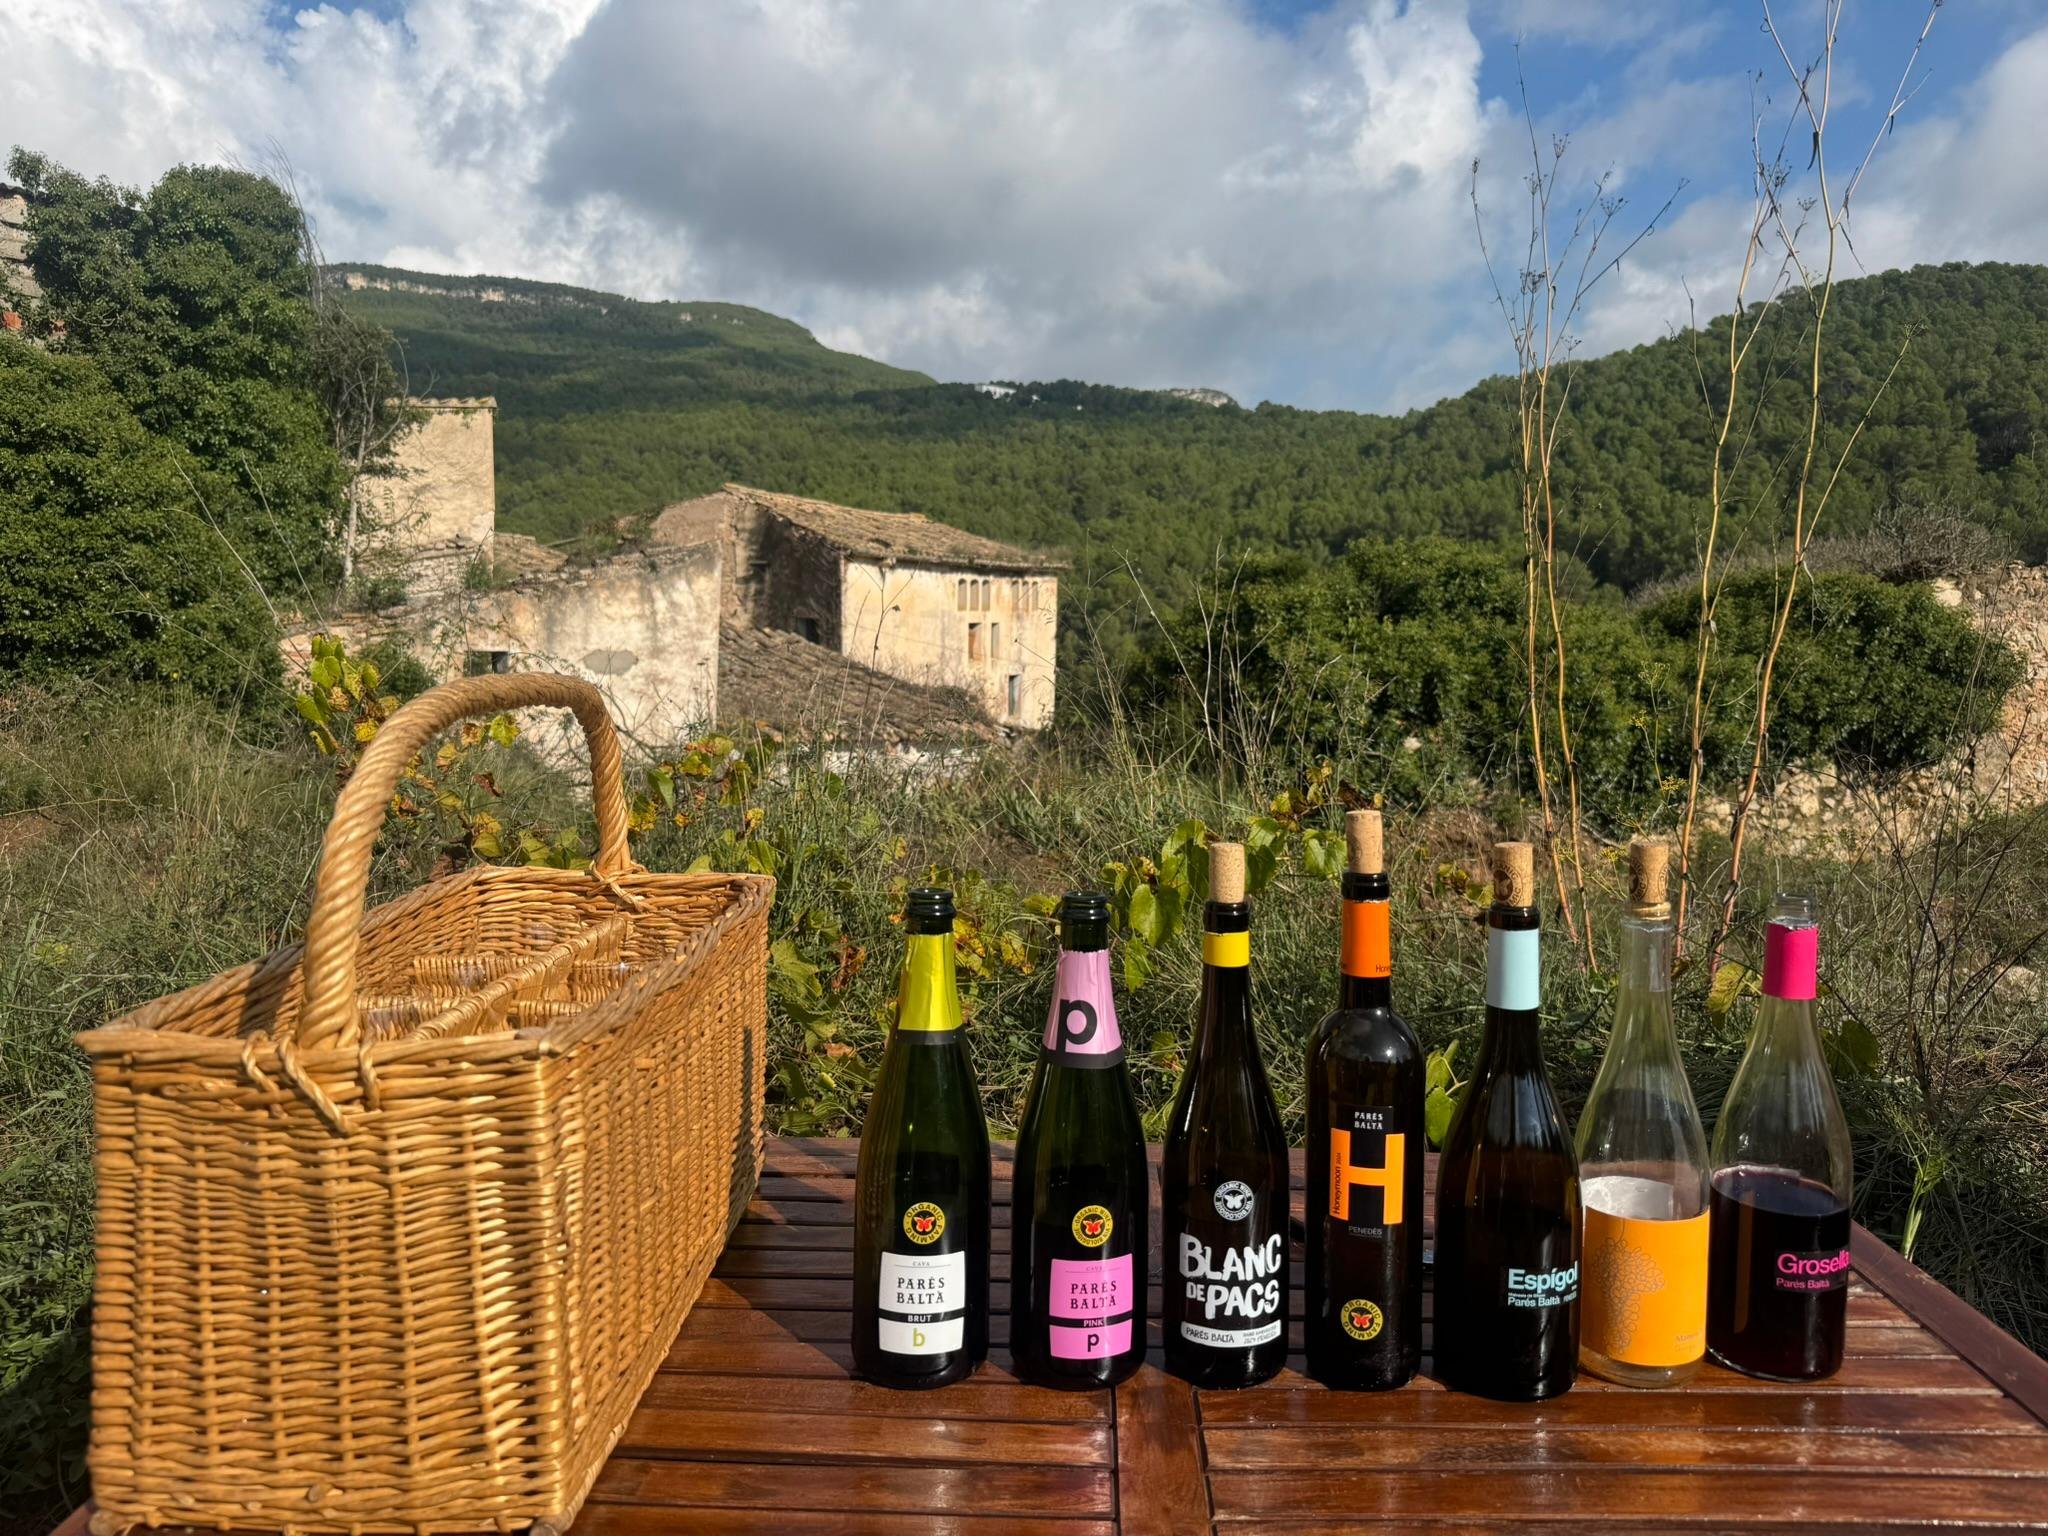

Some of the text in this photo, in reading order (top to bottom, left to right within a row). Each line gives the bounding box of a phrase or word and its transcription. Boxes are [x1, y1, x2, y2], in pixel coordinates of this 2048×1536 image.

[905, 1203, 943, 1243] ORGANIC FARMING
[1179, 1232, 1282, 1282] BLANC
[1186, 1279, 1280, 1320] DE PACS
[907, 1315, 932, 1323] BRUT
[1083, 1319, 1104, 1328] PINK
[1343, 1300, 1381, 1339] ORGANIC FARMING
[912, 1327, 926, 1348] b
[1087, 1333, 1100, 1353] p
